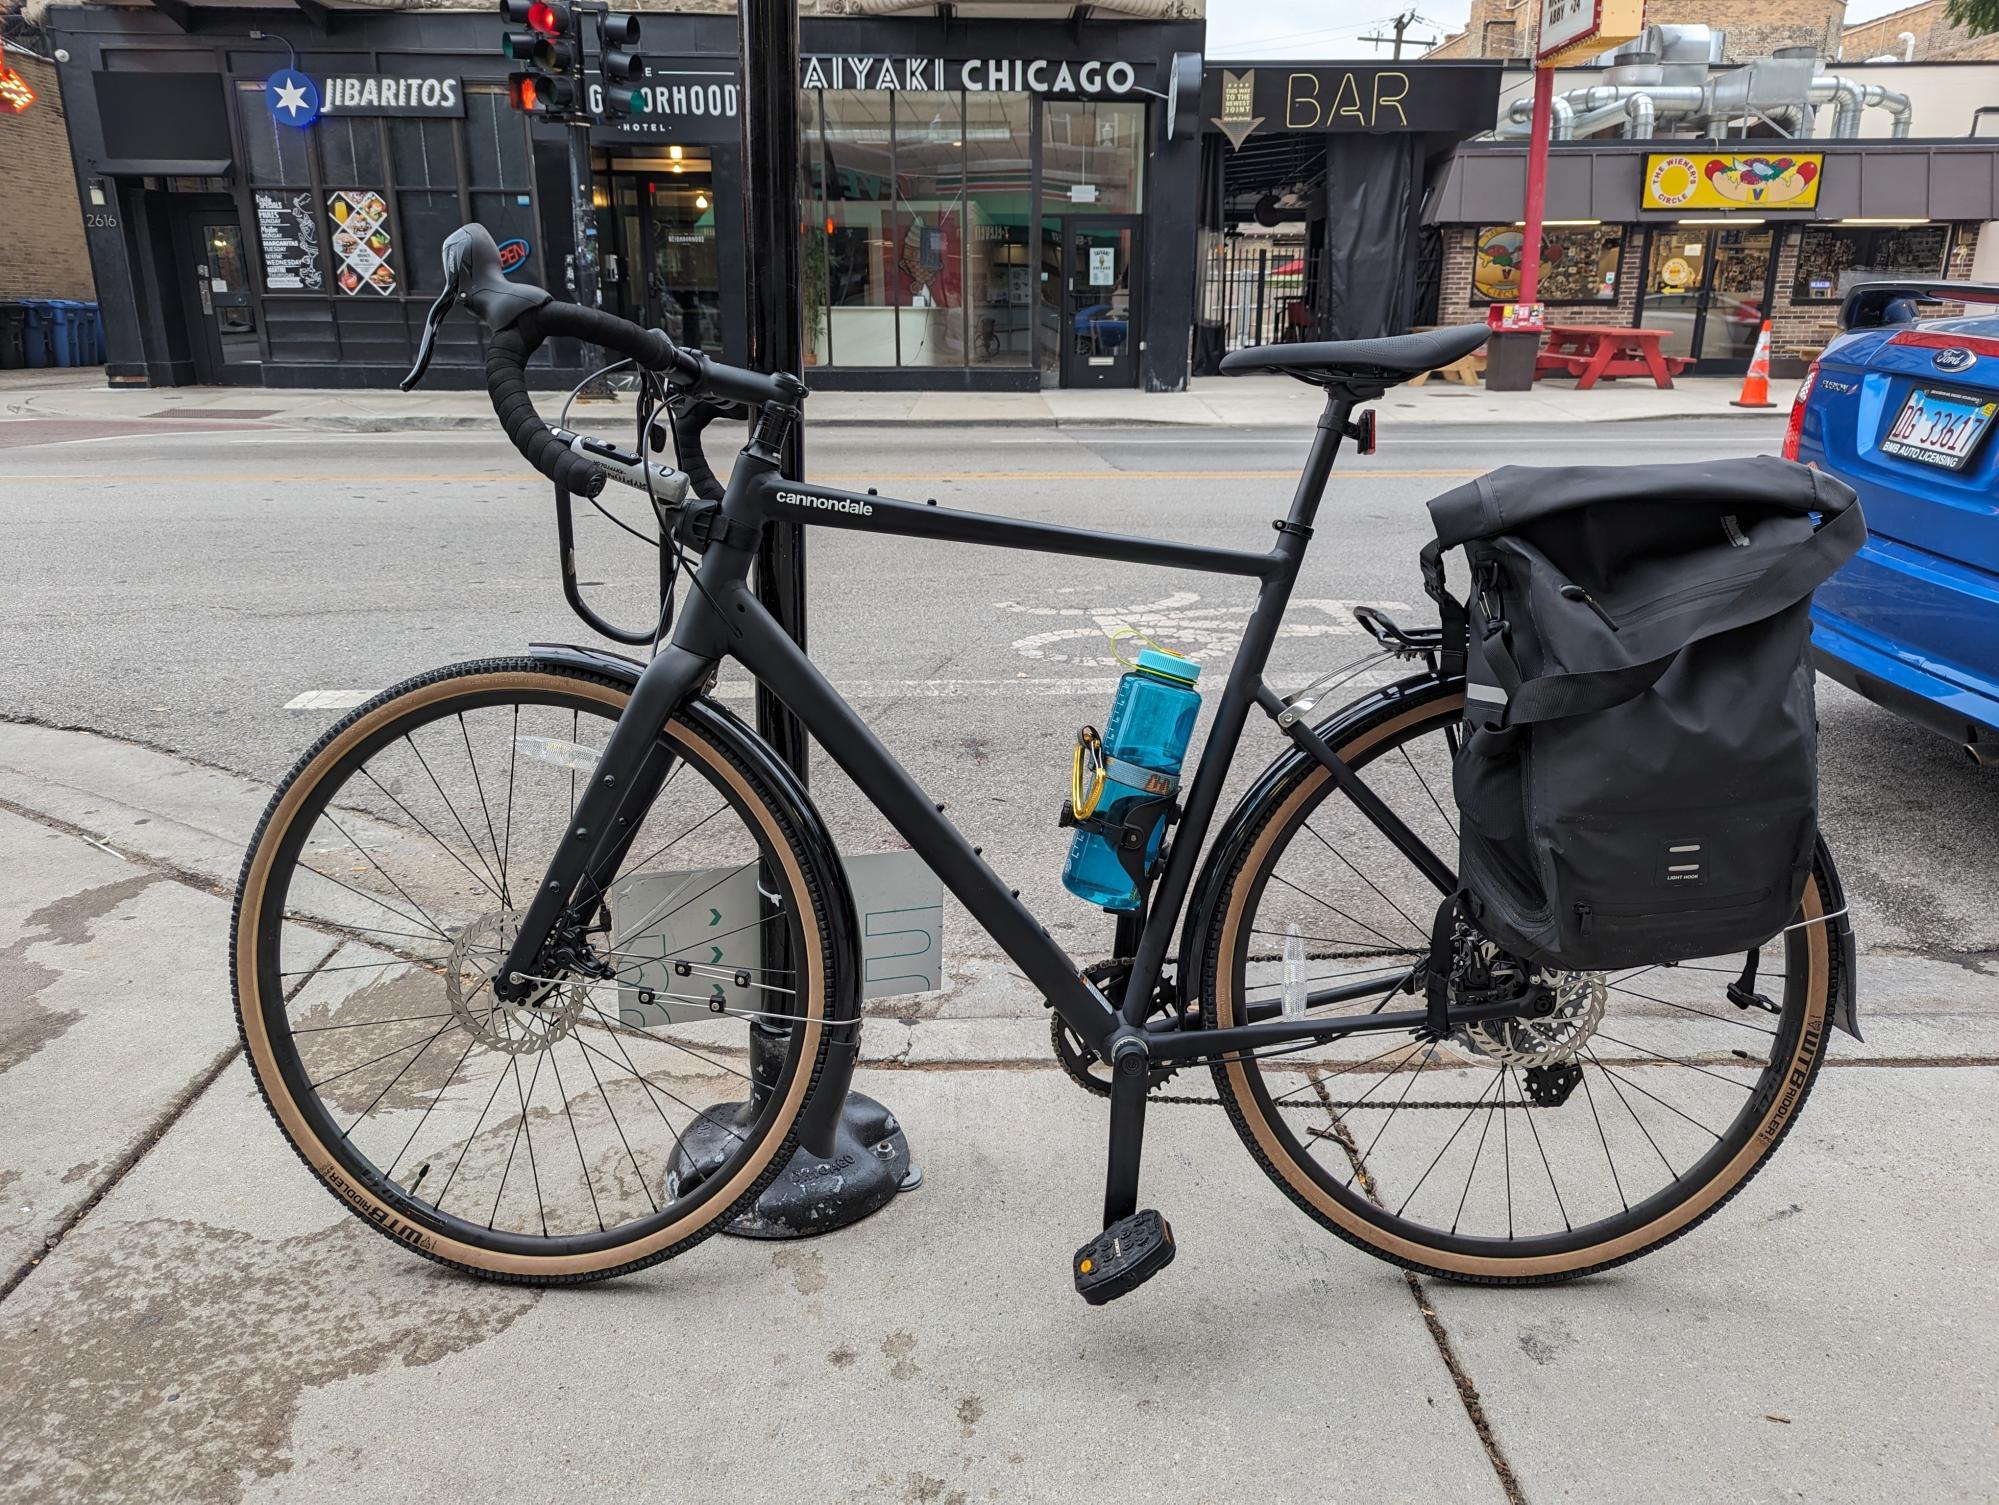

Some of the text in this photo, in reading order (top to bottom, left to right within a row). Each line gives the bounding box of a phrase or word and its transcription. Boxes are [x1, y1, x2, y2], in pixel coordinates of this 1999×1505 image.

[802, 55, 945, 91] AIYAKI
[960, 58, 1136, 94] CHICAGO
[319, 78, 457, 113] JIBARITOS
[588, 83, 738, 117] GORHOOD
[1225, 106, 1251, 114] JOINT
[1286, 71, 1410, 129] BAR
[623, 123, 666, 132] HOTEL
[1653, 157, 1698, 185] THE WIENER'S
[1657, 193, 1688, 204] CIRCLE
[86, 214, 117, 227] 2616
[498, 243, 526, 269] PEN
[1936, 349, 1963, 366] Ford
[1892, 405, 1985, 454] DG 33617
[1882, 441, 1959, 468] BMB AUTO LICENSING
[775, 491, 873, 516] cannondale
[1790, 1030, 1820, 1090] WTB
[1764, 1087, 1797, 1139] RIDDLER
[329, 1172, 372, 1213] RIDDLER
[367, 1206, 424, 1244] WTB
